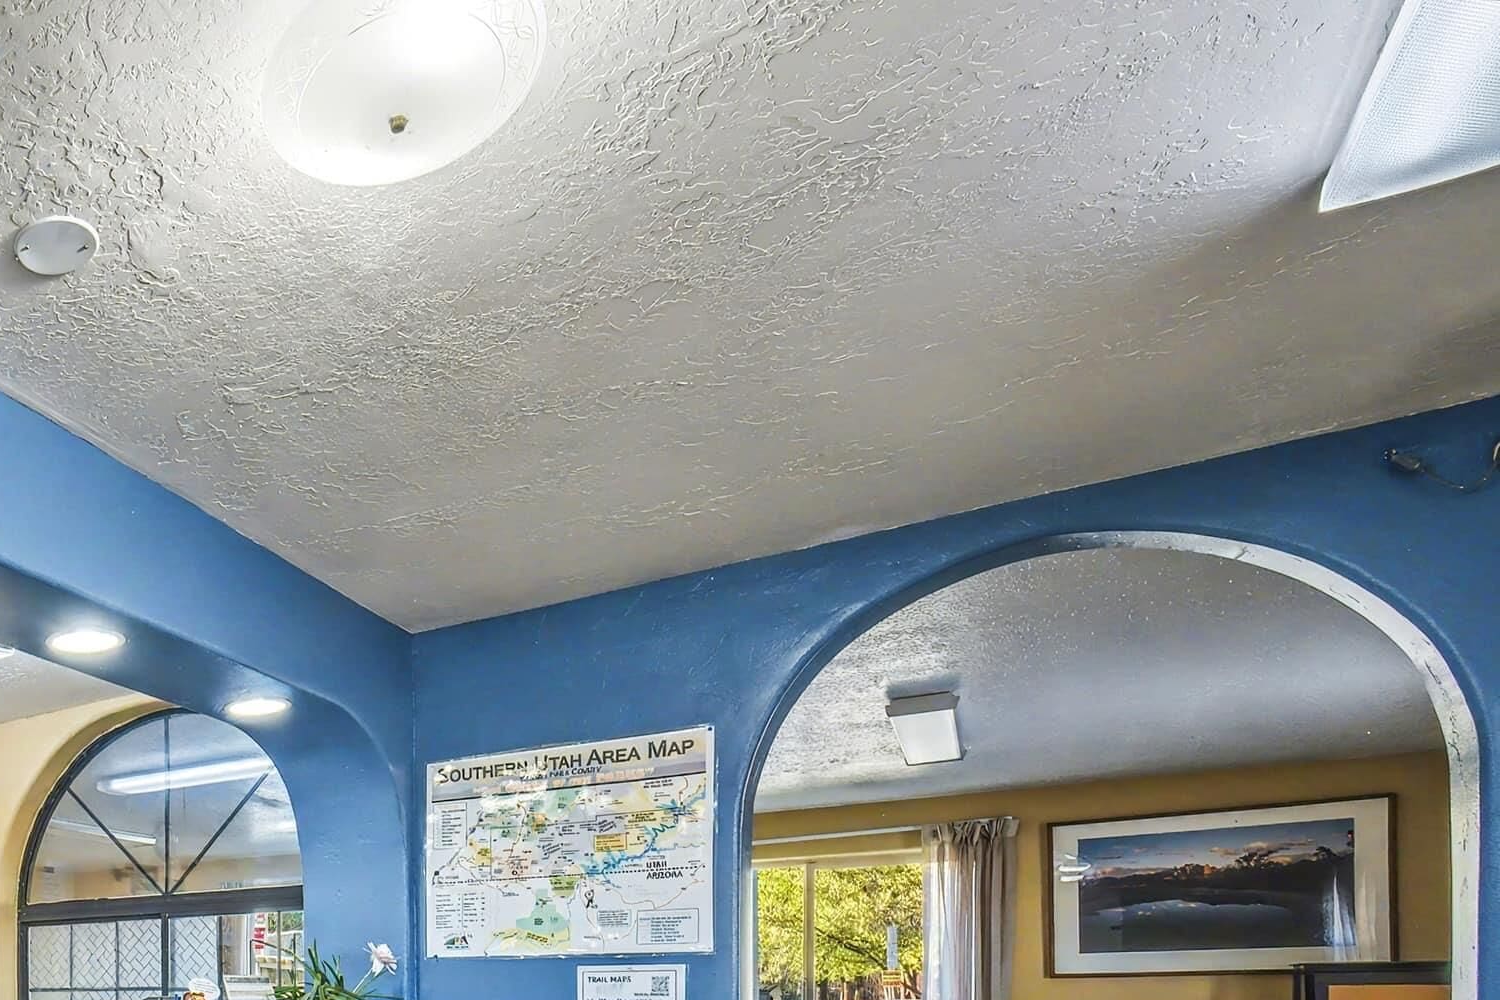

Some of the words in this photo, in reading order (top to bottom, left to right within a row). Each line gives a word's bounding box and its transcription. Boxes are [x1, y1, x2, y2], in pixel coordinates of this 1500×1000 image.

[437, 759, 529, 784] SOUTHERN
[533, 752, 583, 772] UTAH
[588, 747, 641, 769] AREA
[648, 739, 695, 758] MAP
